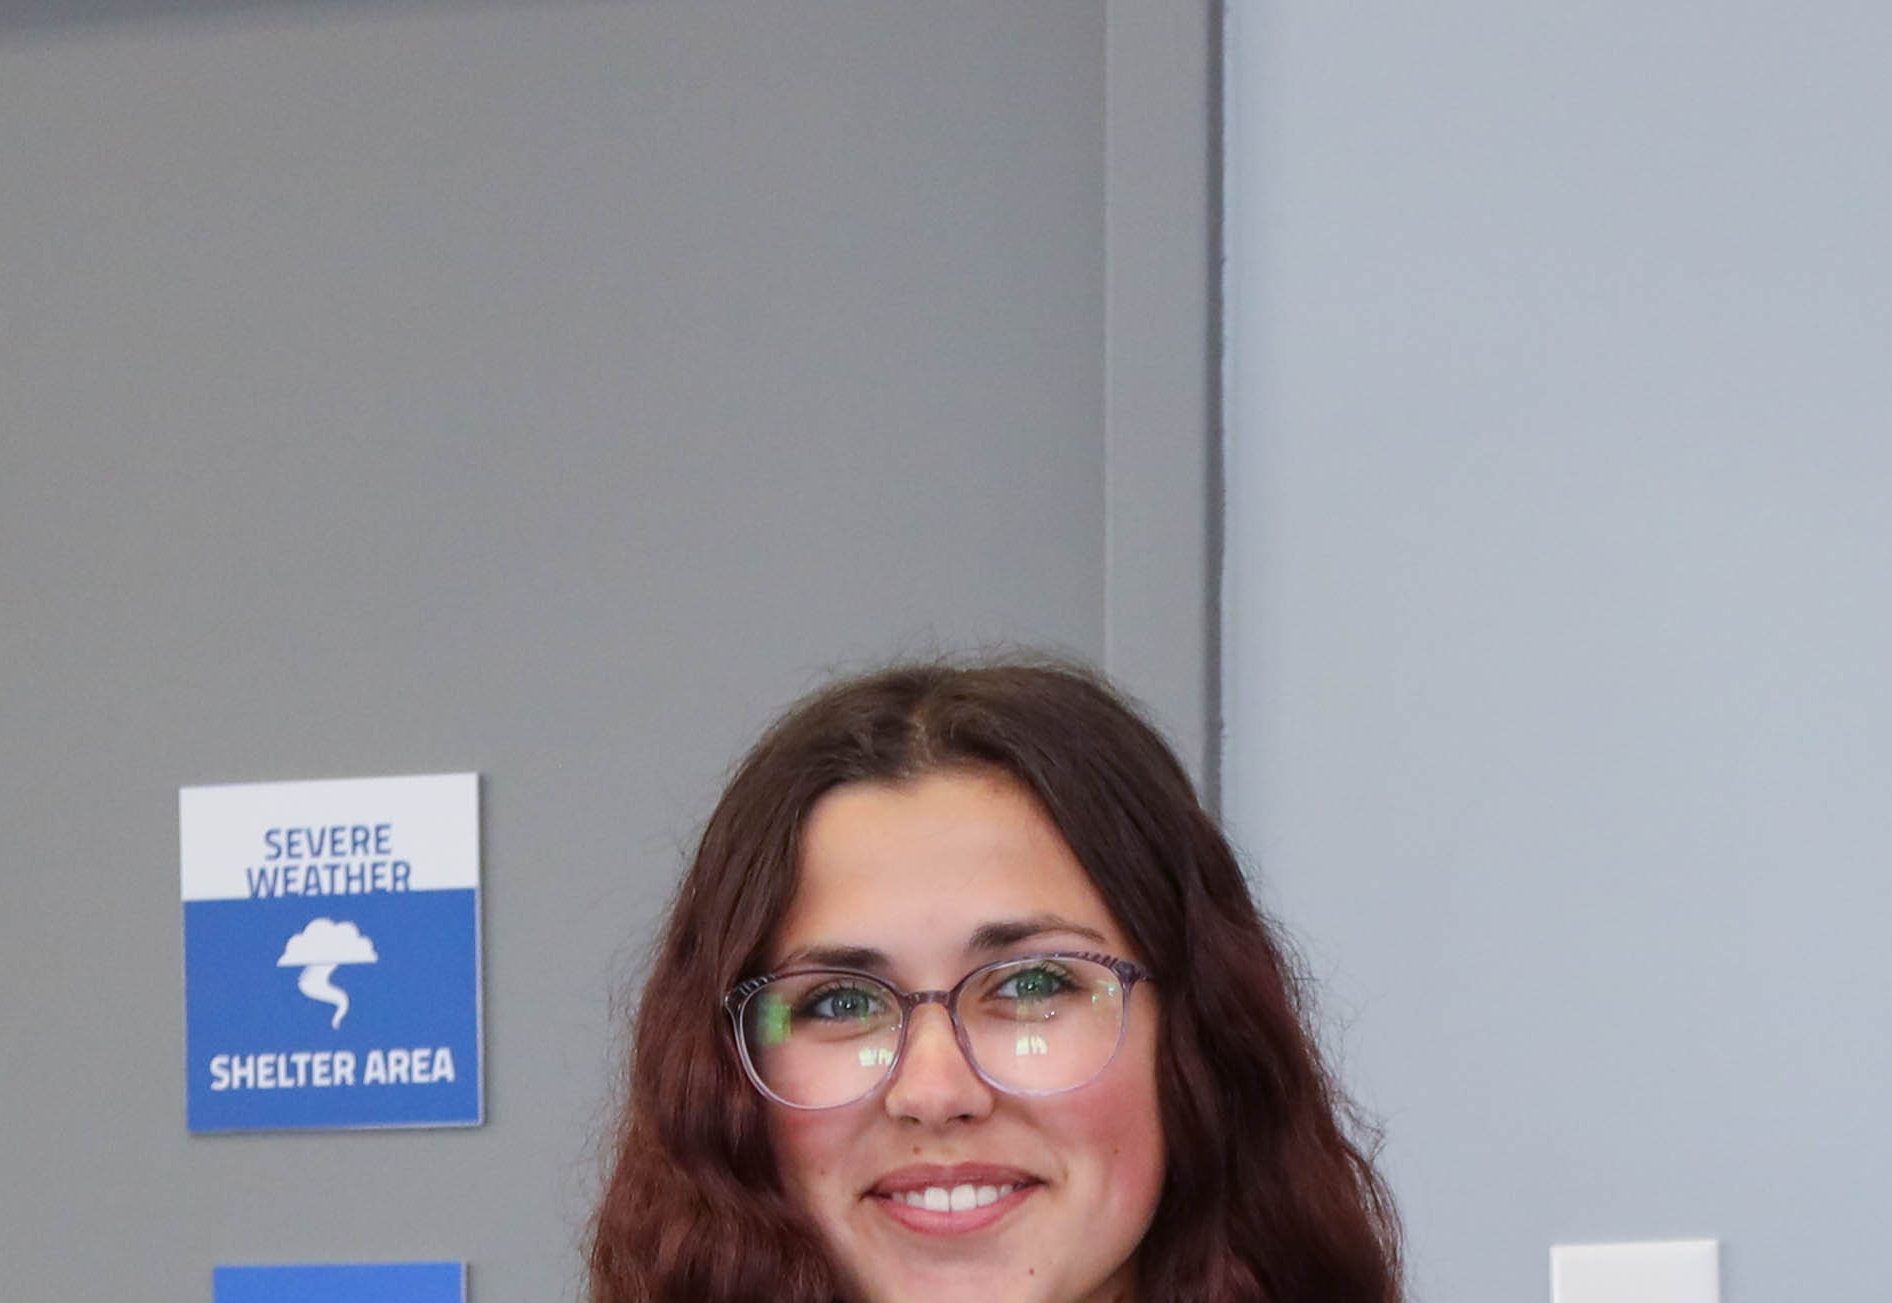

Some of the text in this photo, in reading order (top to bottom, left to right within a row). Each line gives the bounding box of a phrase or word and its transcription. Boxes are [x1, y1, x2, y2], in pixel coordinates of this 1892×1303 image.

[265, 824, 393, 861] SEVERE
[246, 860, 412, 899] WEATHER
[209, 1046, 455, 1091] SHELTER AREA
